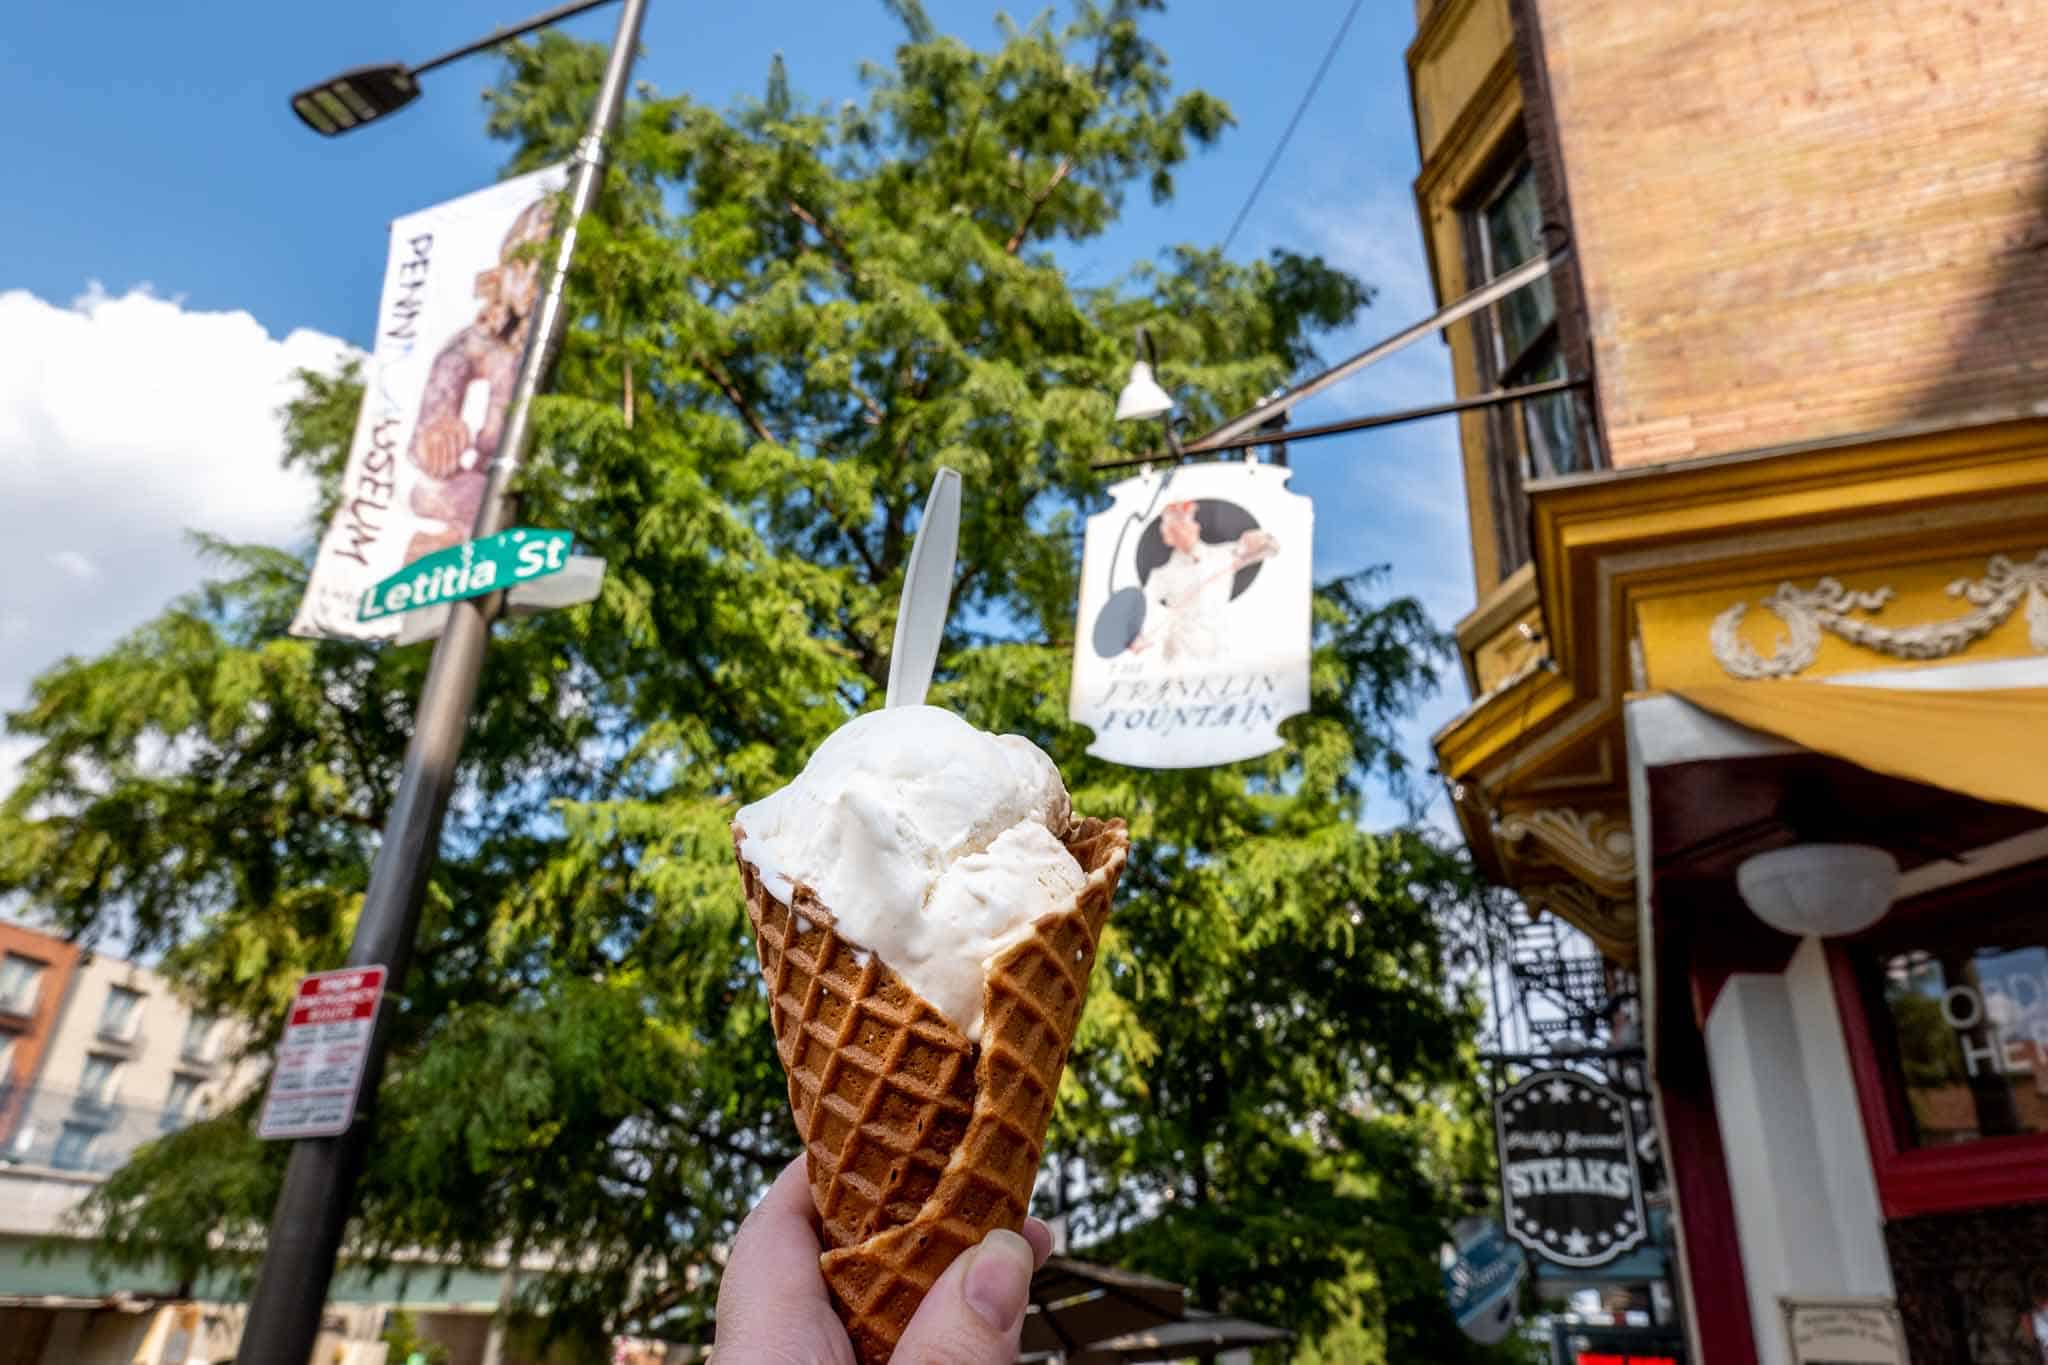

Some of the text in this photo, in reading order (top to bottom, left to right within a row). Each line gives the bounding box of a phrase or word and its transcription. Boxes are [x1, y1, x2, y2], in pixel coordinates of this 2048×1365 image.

[387, 232, 434, 340] PENN
[332, 398, 403, 567] USEUM
[360, 546, 497, 618] Letitia
[513, 536, 566, 578] St
[1096, 670, 1283, 708] FRANKLIN
[1099, 698, 1282, 736] FOUNTAIN
[1504, 1157, 1631, 1198] STEAKS
